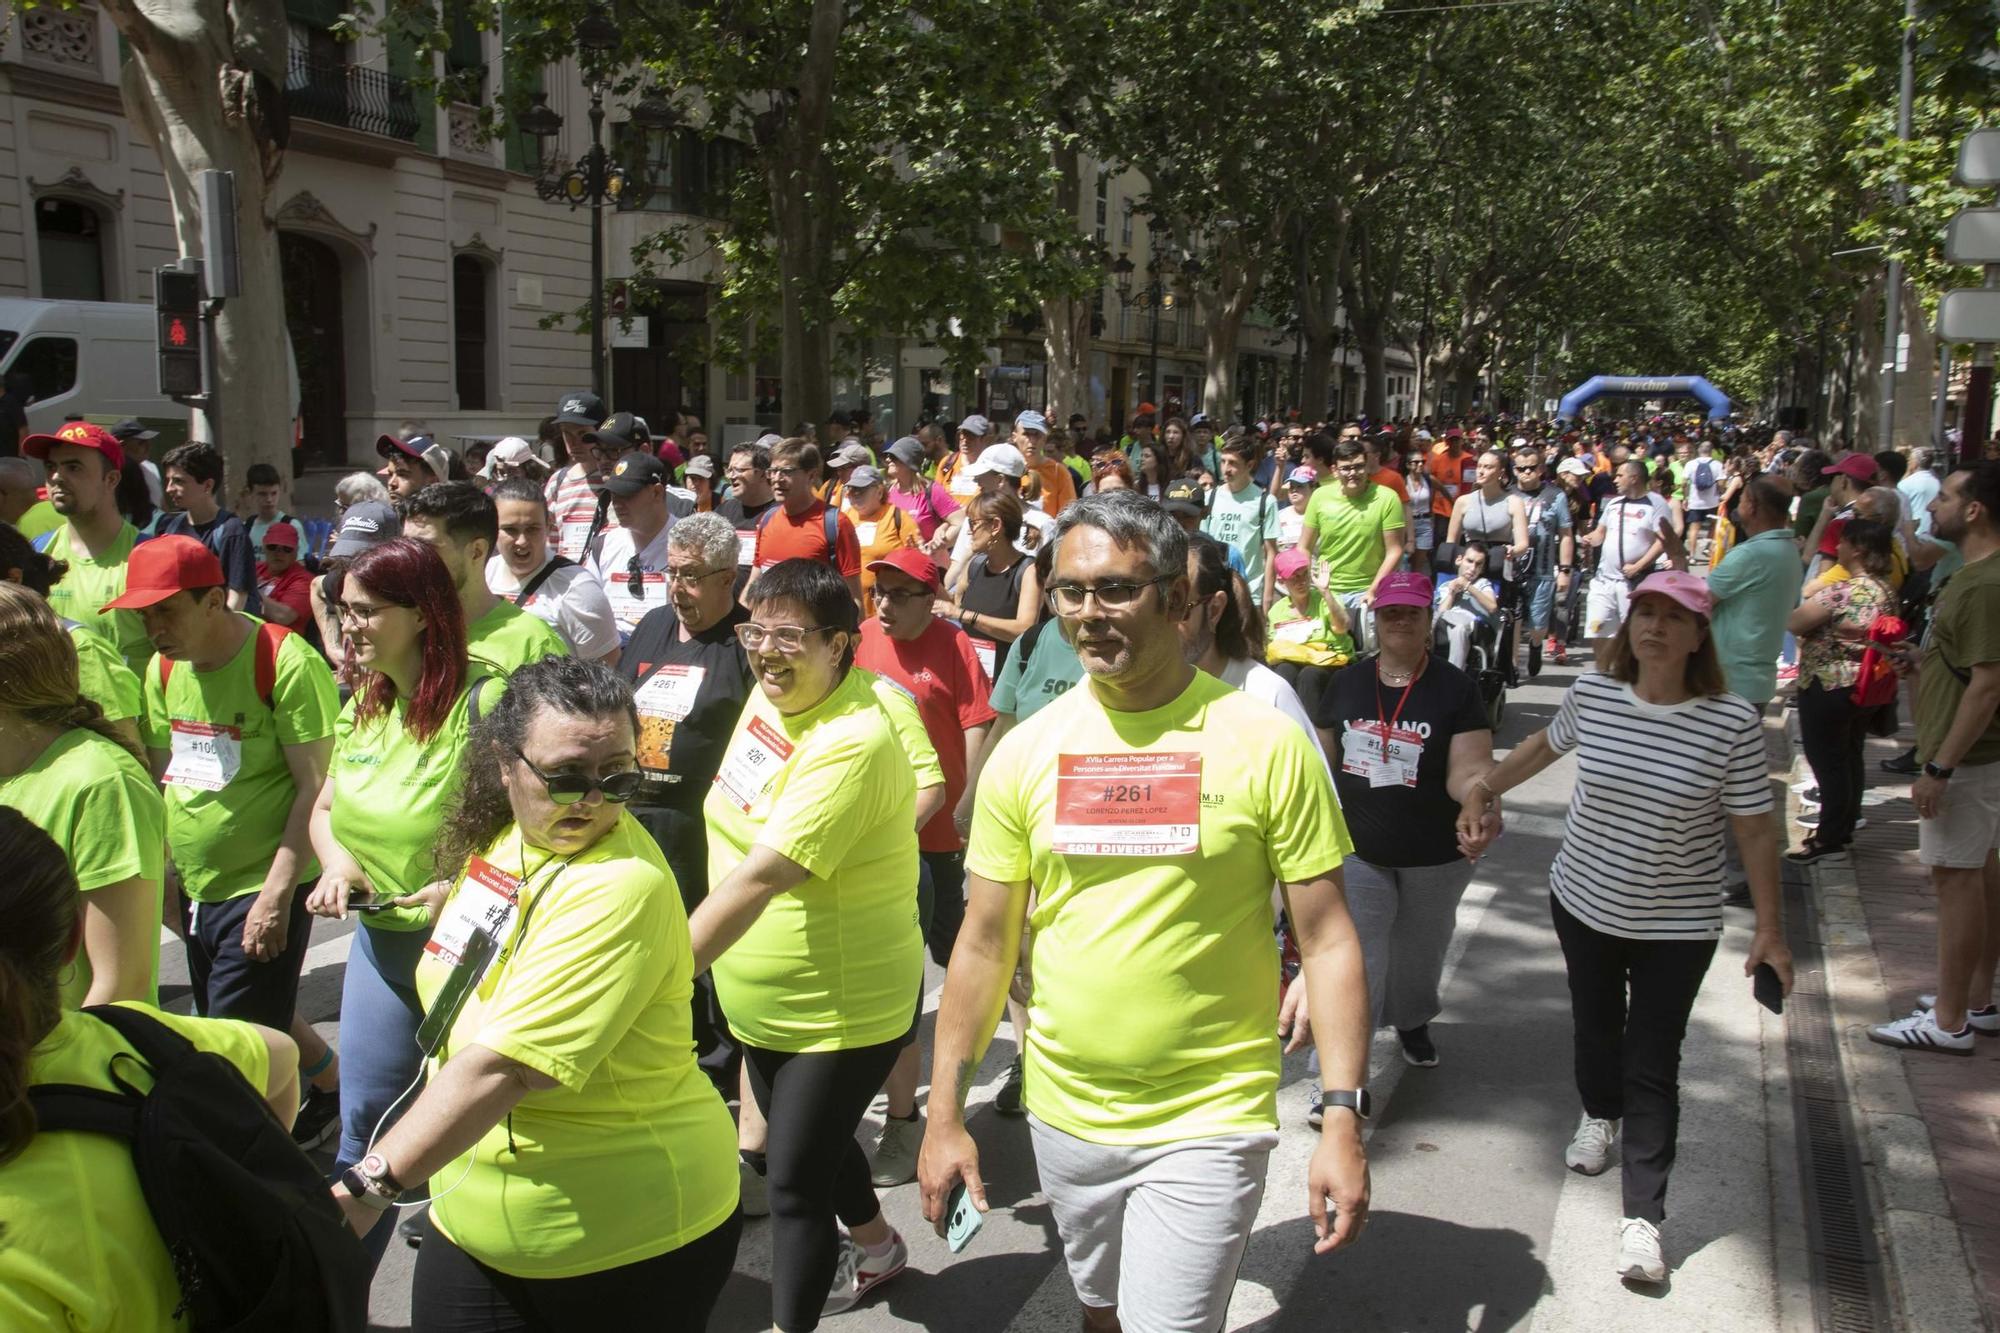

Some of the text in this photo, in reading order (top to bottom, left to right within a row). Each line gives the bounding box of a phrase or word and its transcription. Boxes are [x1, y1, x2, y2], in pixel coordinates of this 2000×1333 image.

[1623, 380, 1669, 391] mychip
[1220, 513, 1241, 521] SOM
[1225, 523, 1235, 531] DI
[1219, 533, 1239, 542] VER
[1368, 739, 1401, 755] #105
[746, 747, 767, 766] #261
[1129, 755, 1155, 764] Popular
[1156, 755, 1168, 763] per
[1103, 785, 1152, 802] #261
[1067, 843, 1098, 853] SOM
